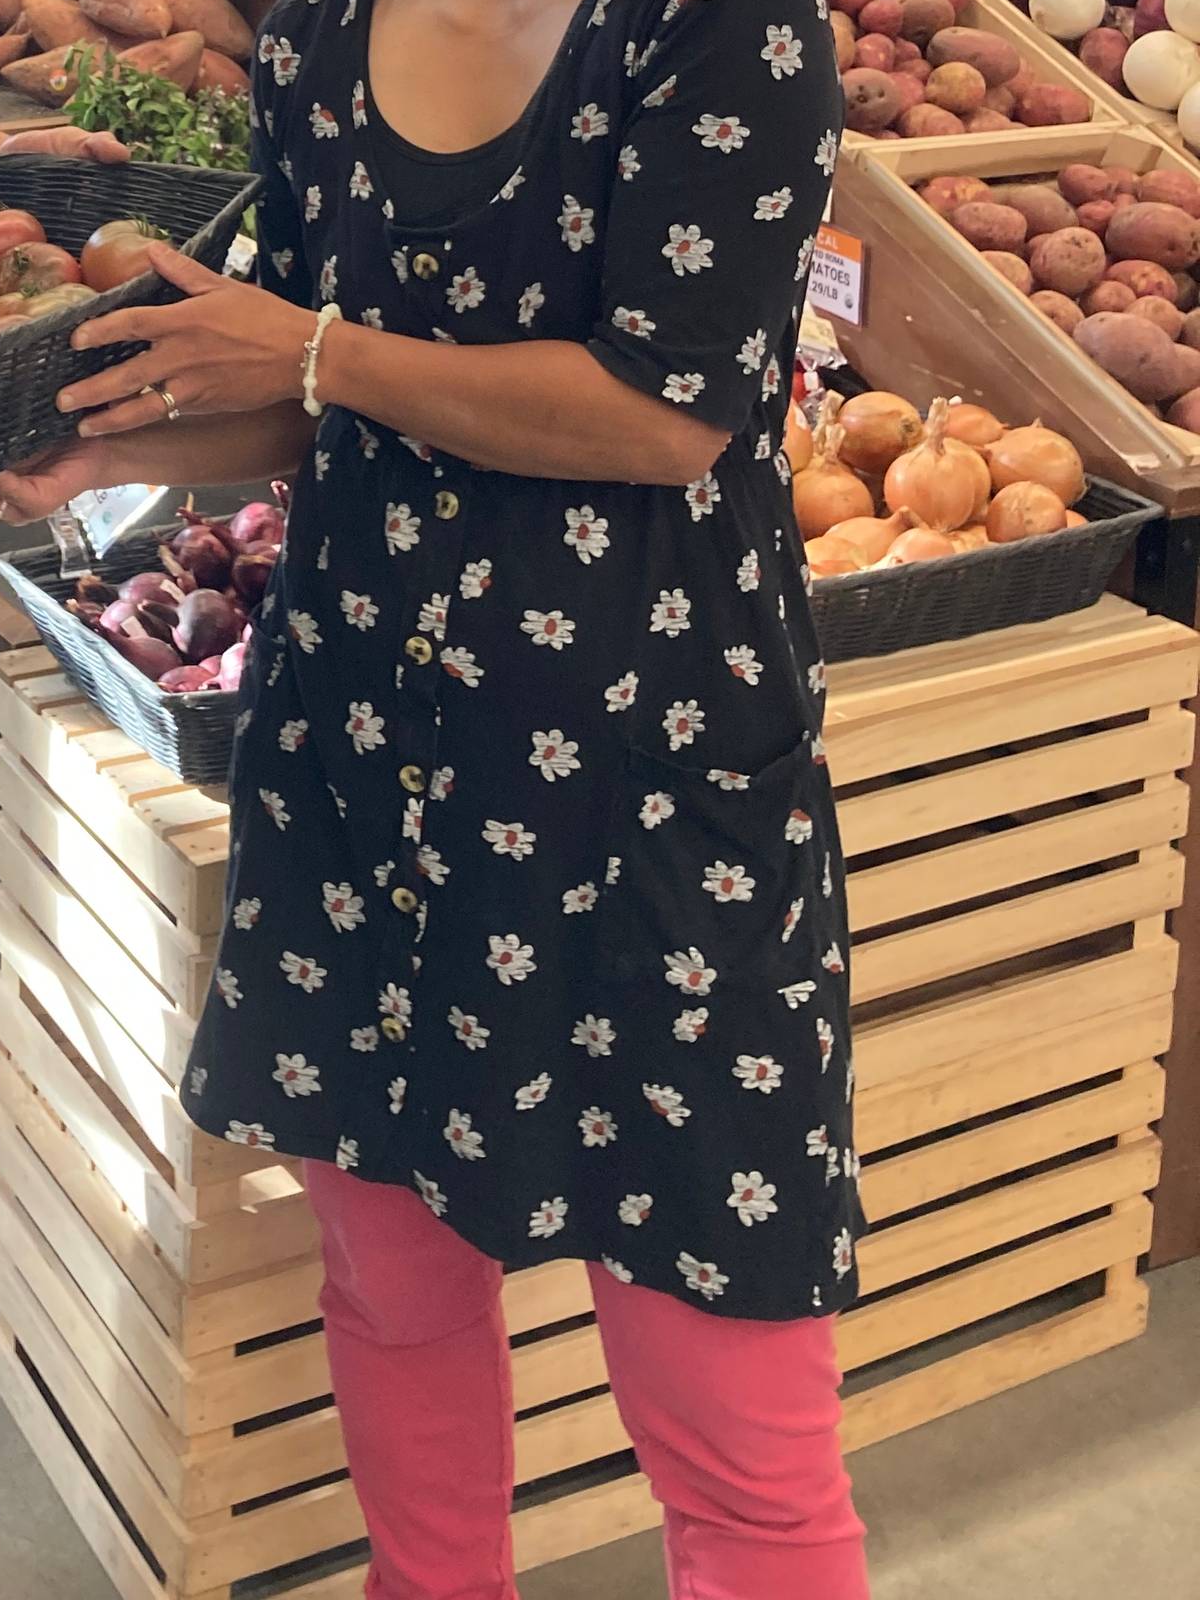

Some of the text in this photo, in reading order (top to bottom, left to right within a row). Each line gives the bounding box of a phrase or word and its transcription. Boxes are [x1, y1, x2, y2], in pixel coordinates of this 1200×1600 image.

[819, 230, 839, 250] CAL
[811, 262, 850, 287] MATOES
[810, 281, 838, 300] .29/LB
